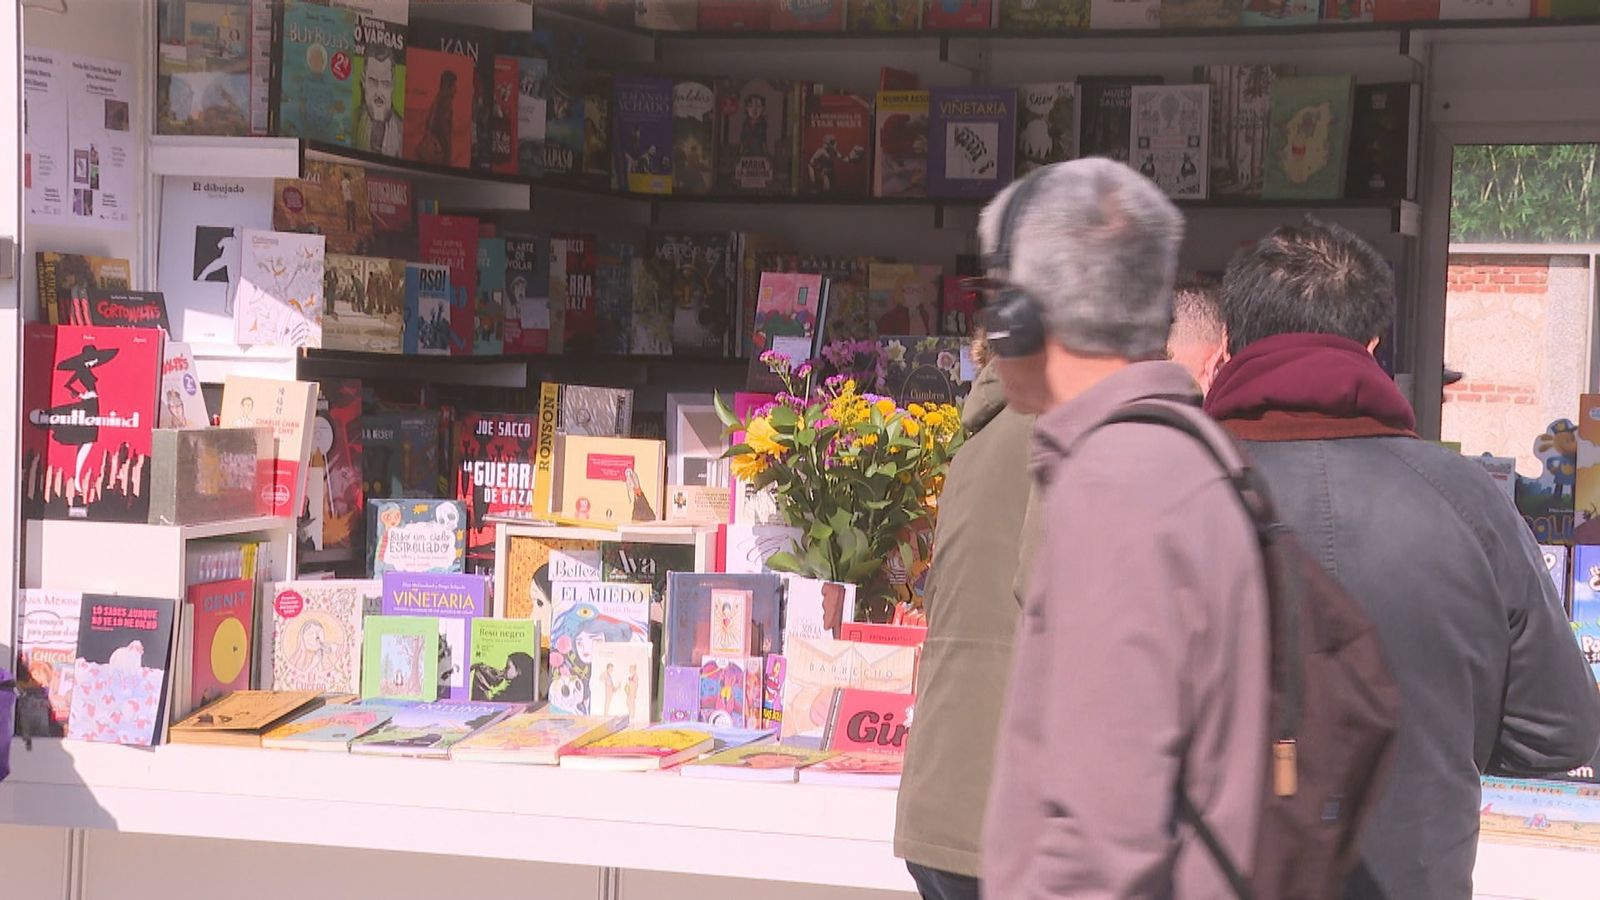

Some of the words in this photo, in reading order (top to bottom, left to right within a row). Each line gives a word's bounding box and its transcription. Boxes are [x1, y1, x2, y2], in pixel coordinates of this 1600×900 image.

[364, 28, 404, 50] VARGAS
[193, 182, 202, 192] El
[203, 182, 245, 195] dibujado
[476, 419, 494, 435] JOE
[498, 421, 531, 438] SACCO
[539, 395, 555, 472] RONSON
[464, 460, 473, 472] LA
[485, 488, 498, 503] DE
[501, 490, 533, 506] GAZA
[393, 588, 475, 610] VIÑETARIA
[562, 586, 582, 602] EL
[588, 587, 645, 603] MIEDO
[499, 630, 525, 640] negro
